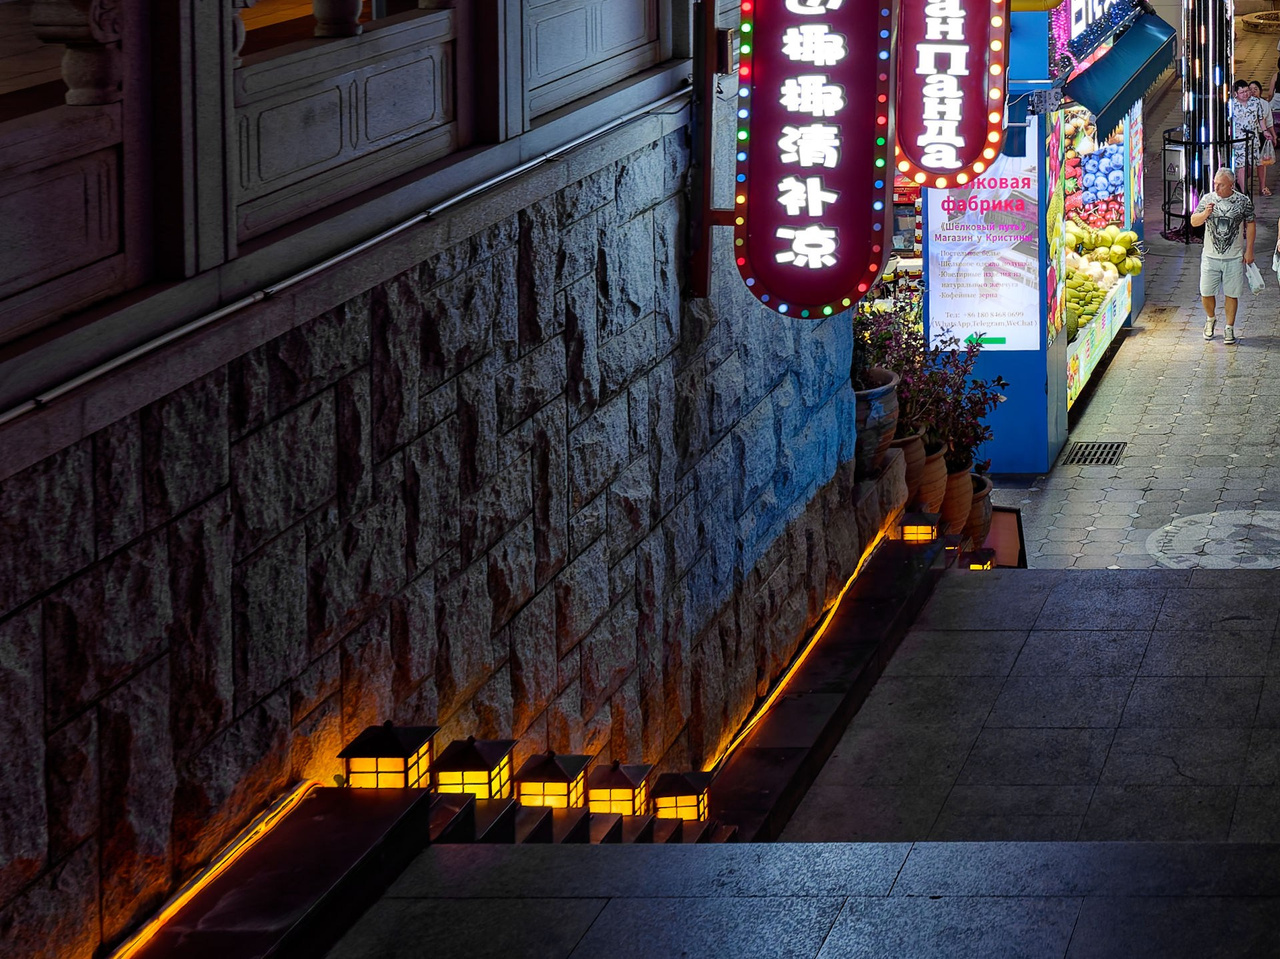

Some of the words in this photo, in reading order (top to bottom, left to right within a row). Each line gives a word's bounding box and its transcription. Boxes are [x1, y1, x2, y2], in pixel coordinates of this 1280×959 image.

[915, 43, 970, 169] Панда
[941, 195, 1025, 215] фабрика
[934, 234, 973, 242] Магазин
[986, 234, 1033, 243] Кристины
